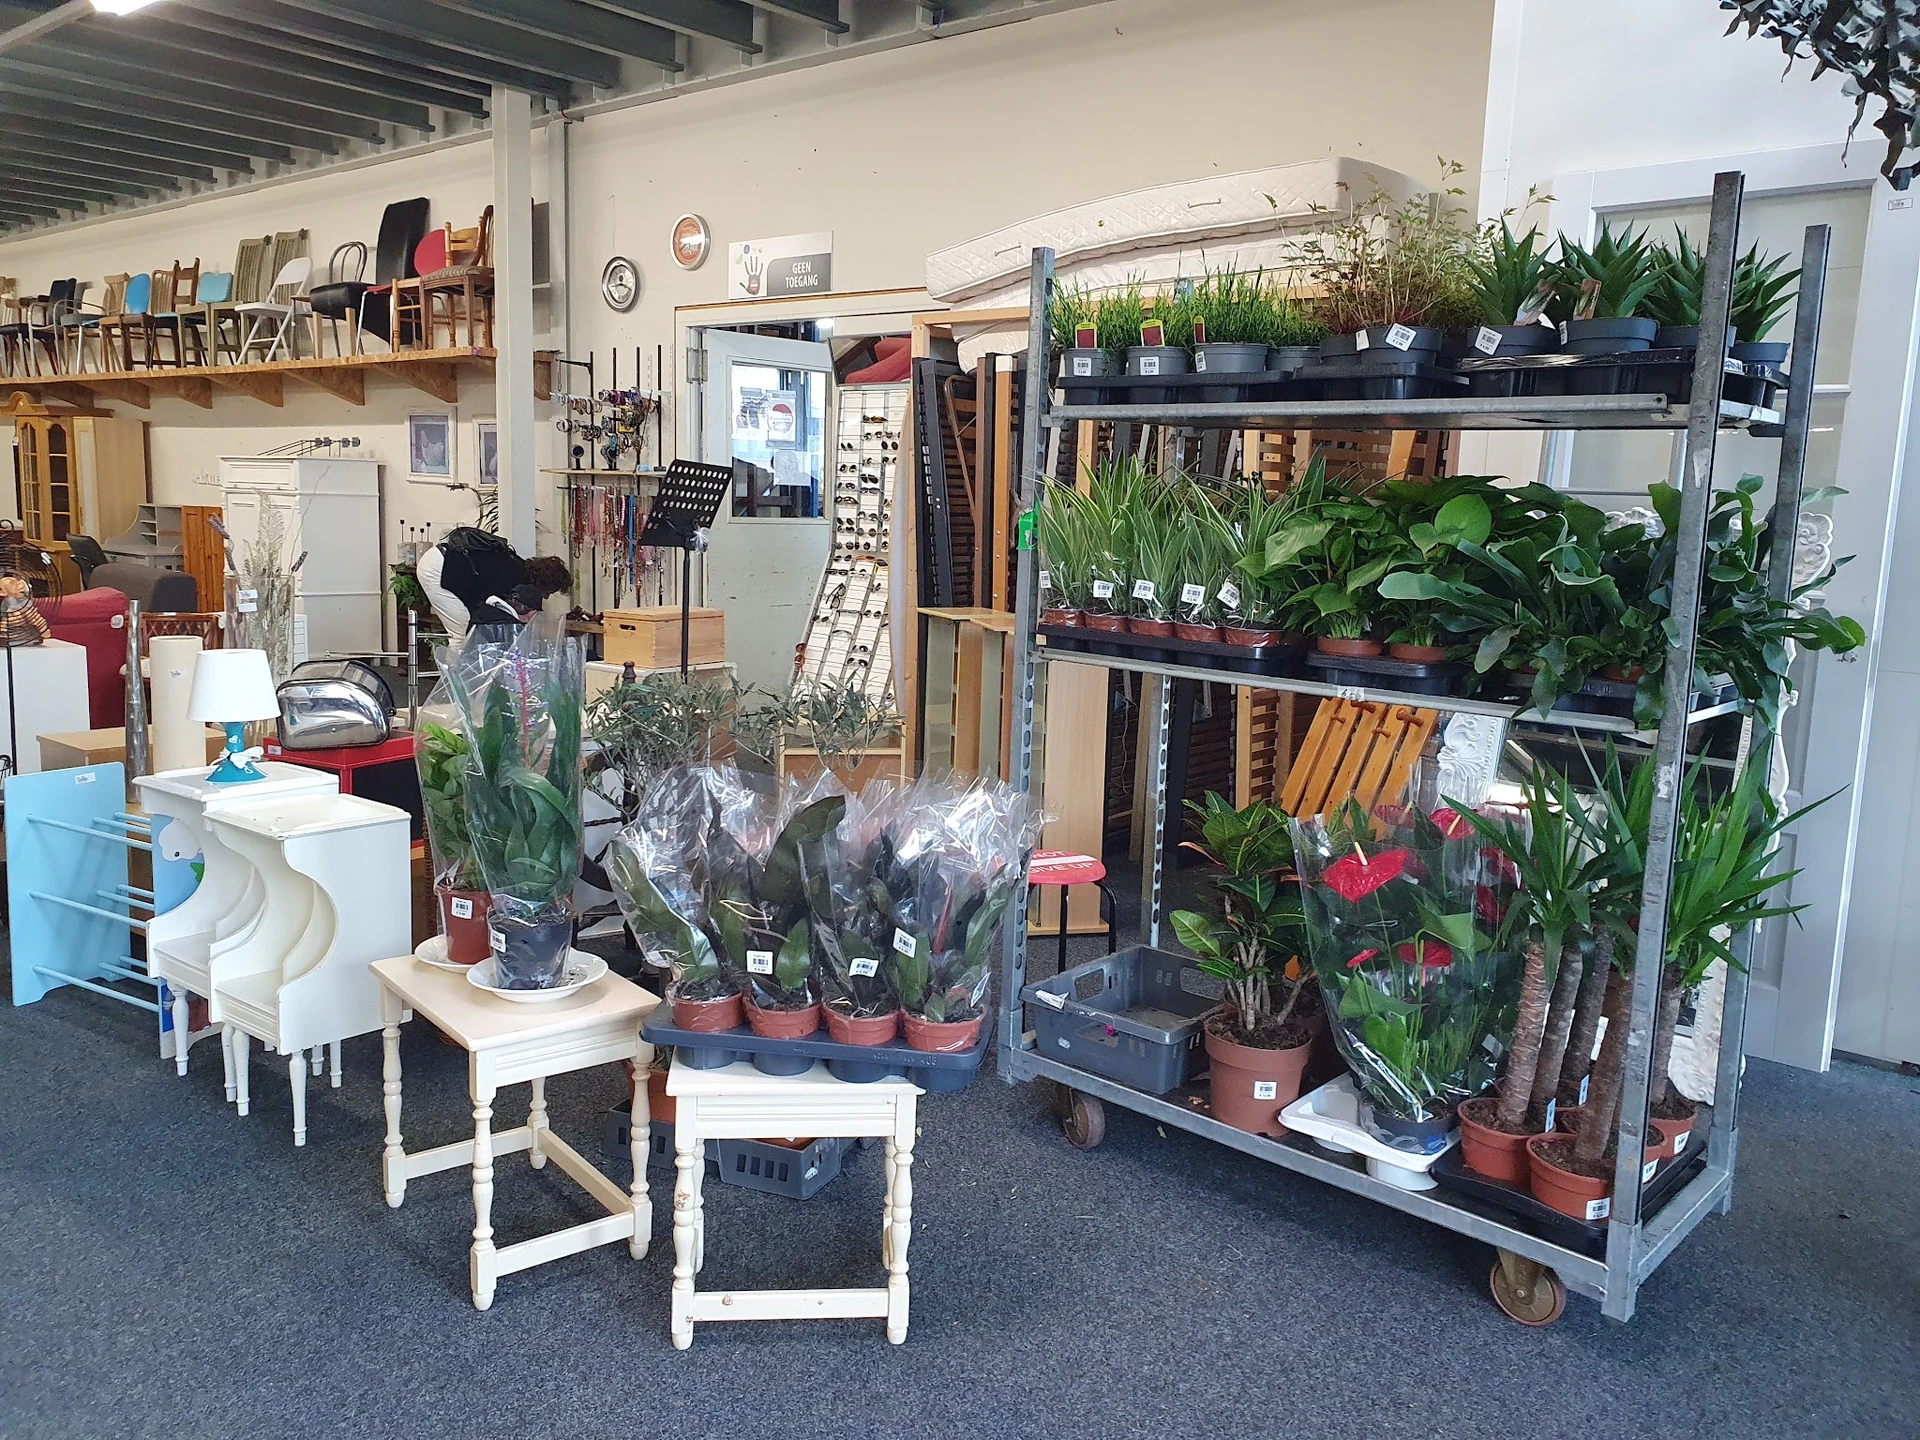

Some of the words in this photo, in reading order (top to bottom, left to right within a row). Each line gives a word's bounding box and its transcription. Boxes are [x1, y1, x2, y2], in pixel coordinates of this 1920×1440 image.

[792, 261, 811, 273] GEEN
[785, 274, 818, 288] TOEGANG
[1030, 864, 1069, 873] GIVE
